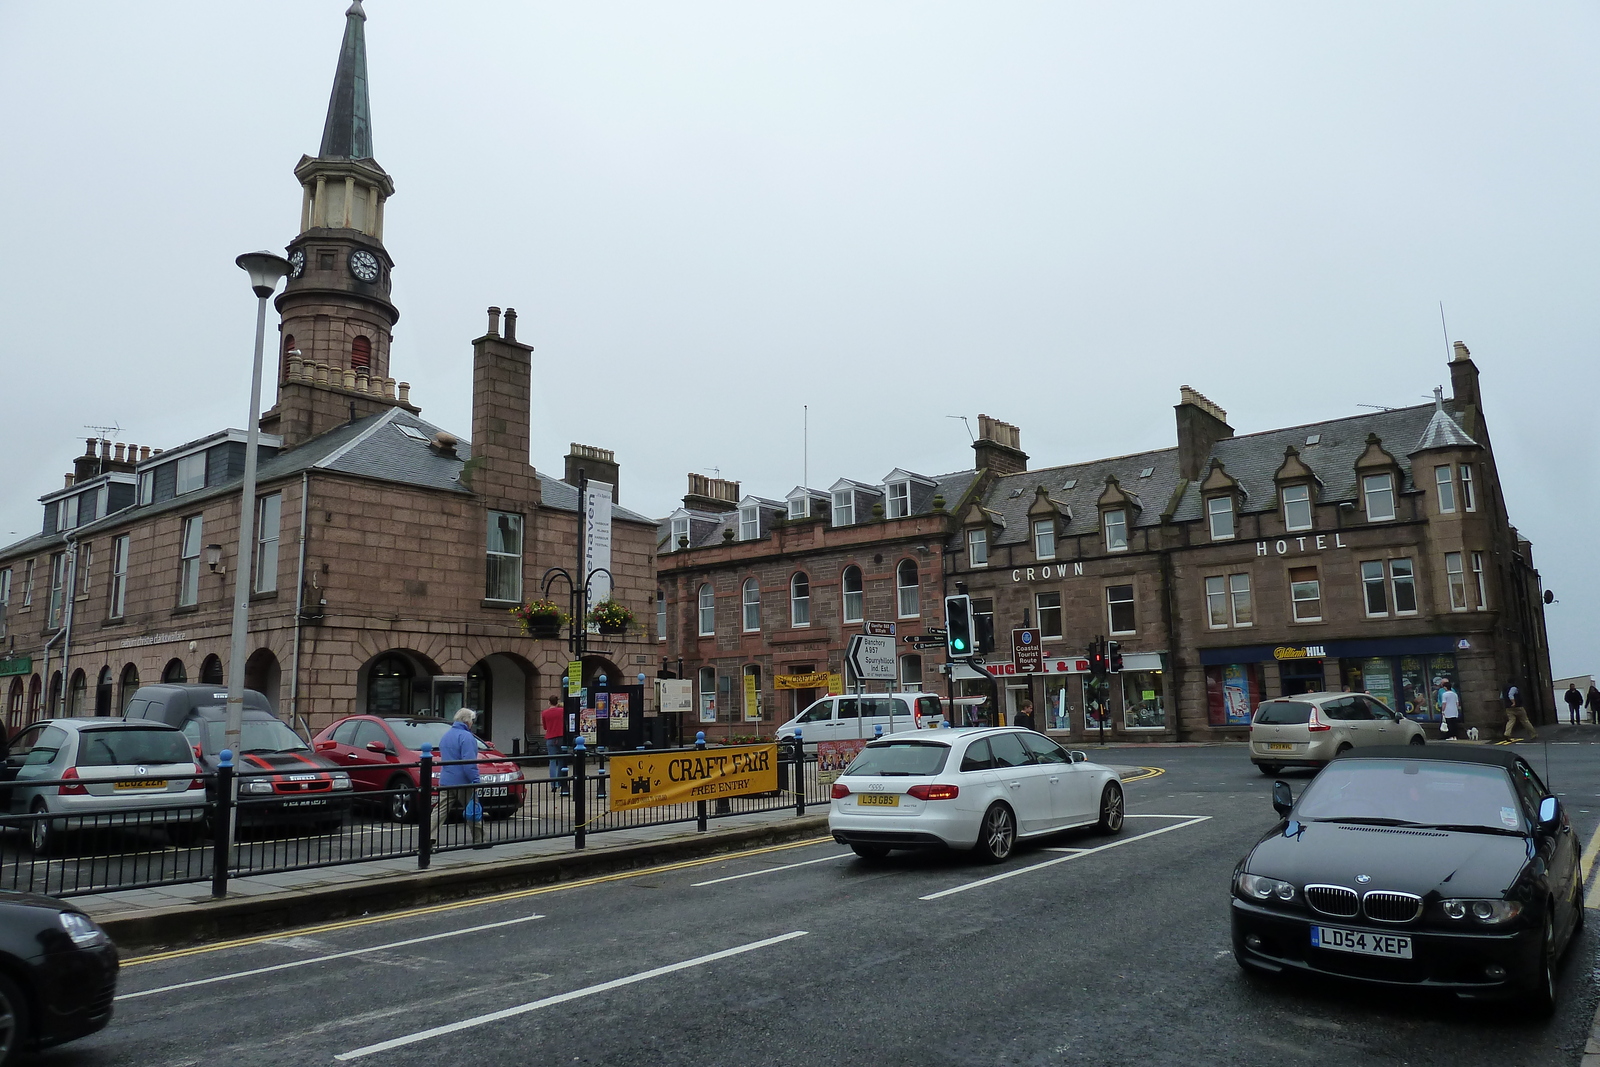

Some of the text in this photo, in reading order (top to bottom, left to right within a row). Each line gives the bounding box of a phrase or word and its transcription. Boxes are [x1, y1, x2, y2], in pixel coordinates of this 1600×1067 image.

[1256, 533, 1346, 556] HOTEL
[1012, 562, 1083, 582] CROWN
[864, 639, 886, 647] Banchory
[1306, 645, 1326, 657] HILL
[865, 656, 895, 664] Spurryhillock
[620, 760, 662, 790] FOCUS
[668, 750, 770, 783] CRAFT FAIR
[690, 778, 751, 797] FREE ENTRY
[862, 794, 894, 805] L33 GBS
[1321, 929, 1409, 955] LD54 XEP
